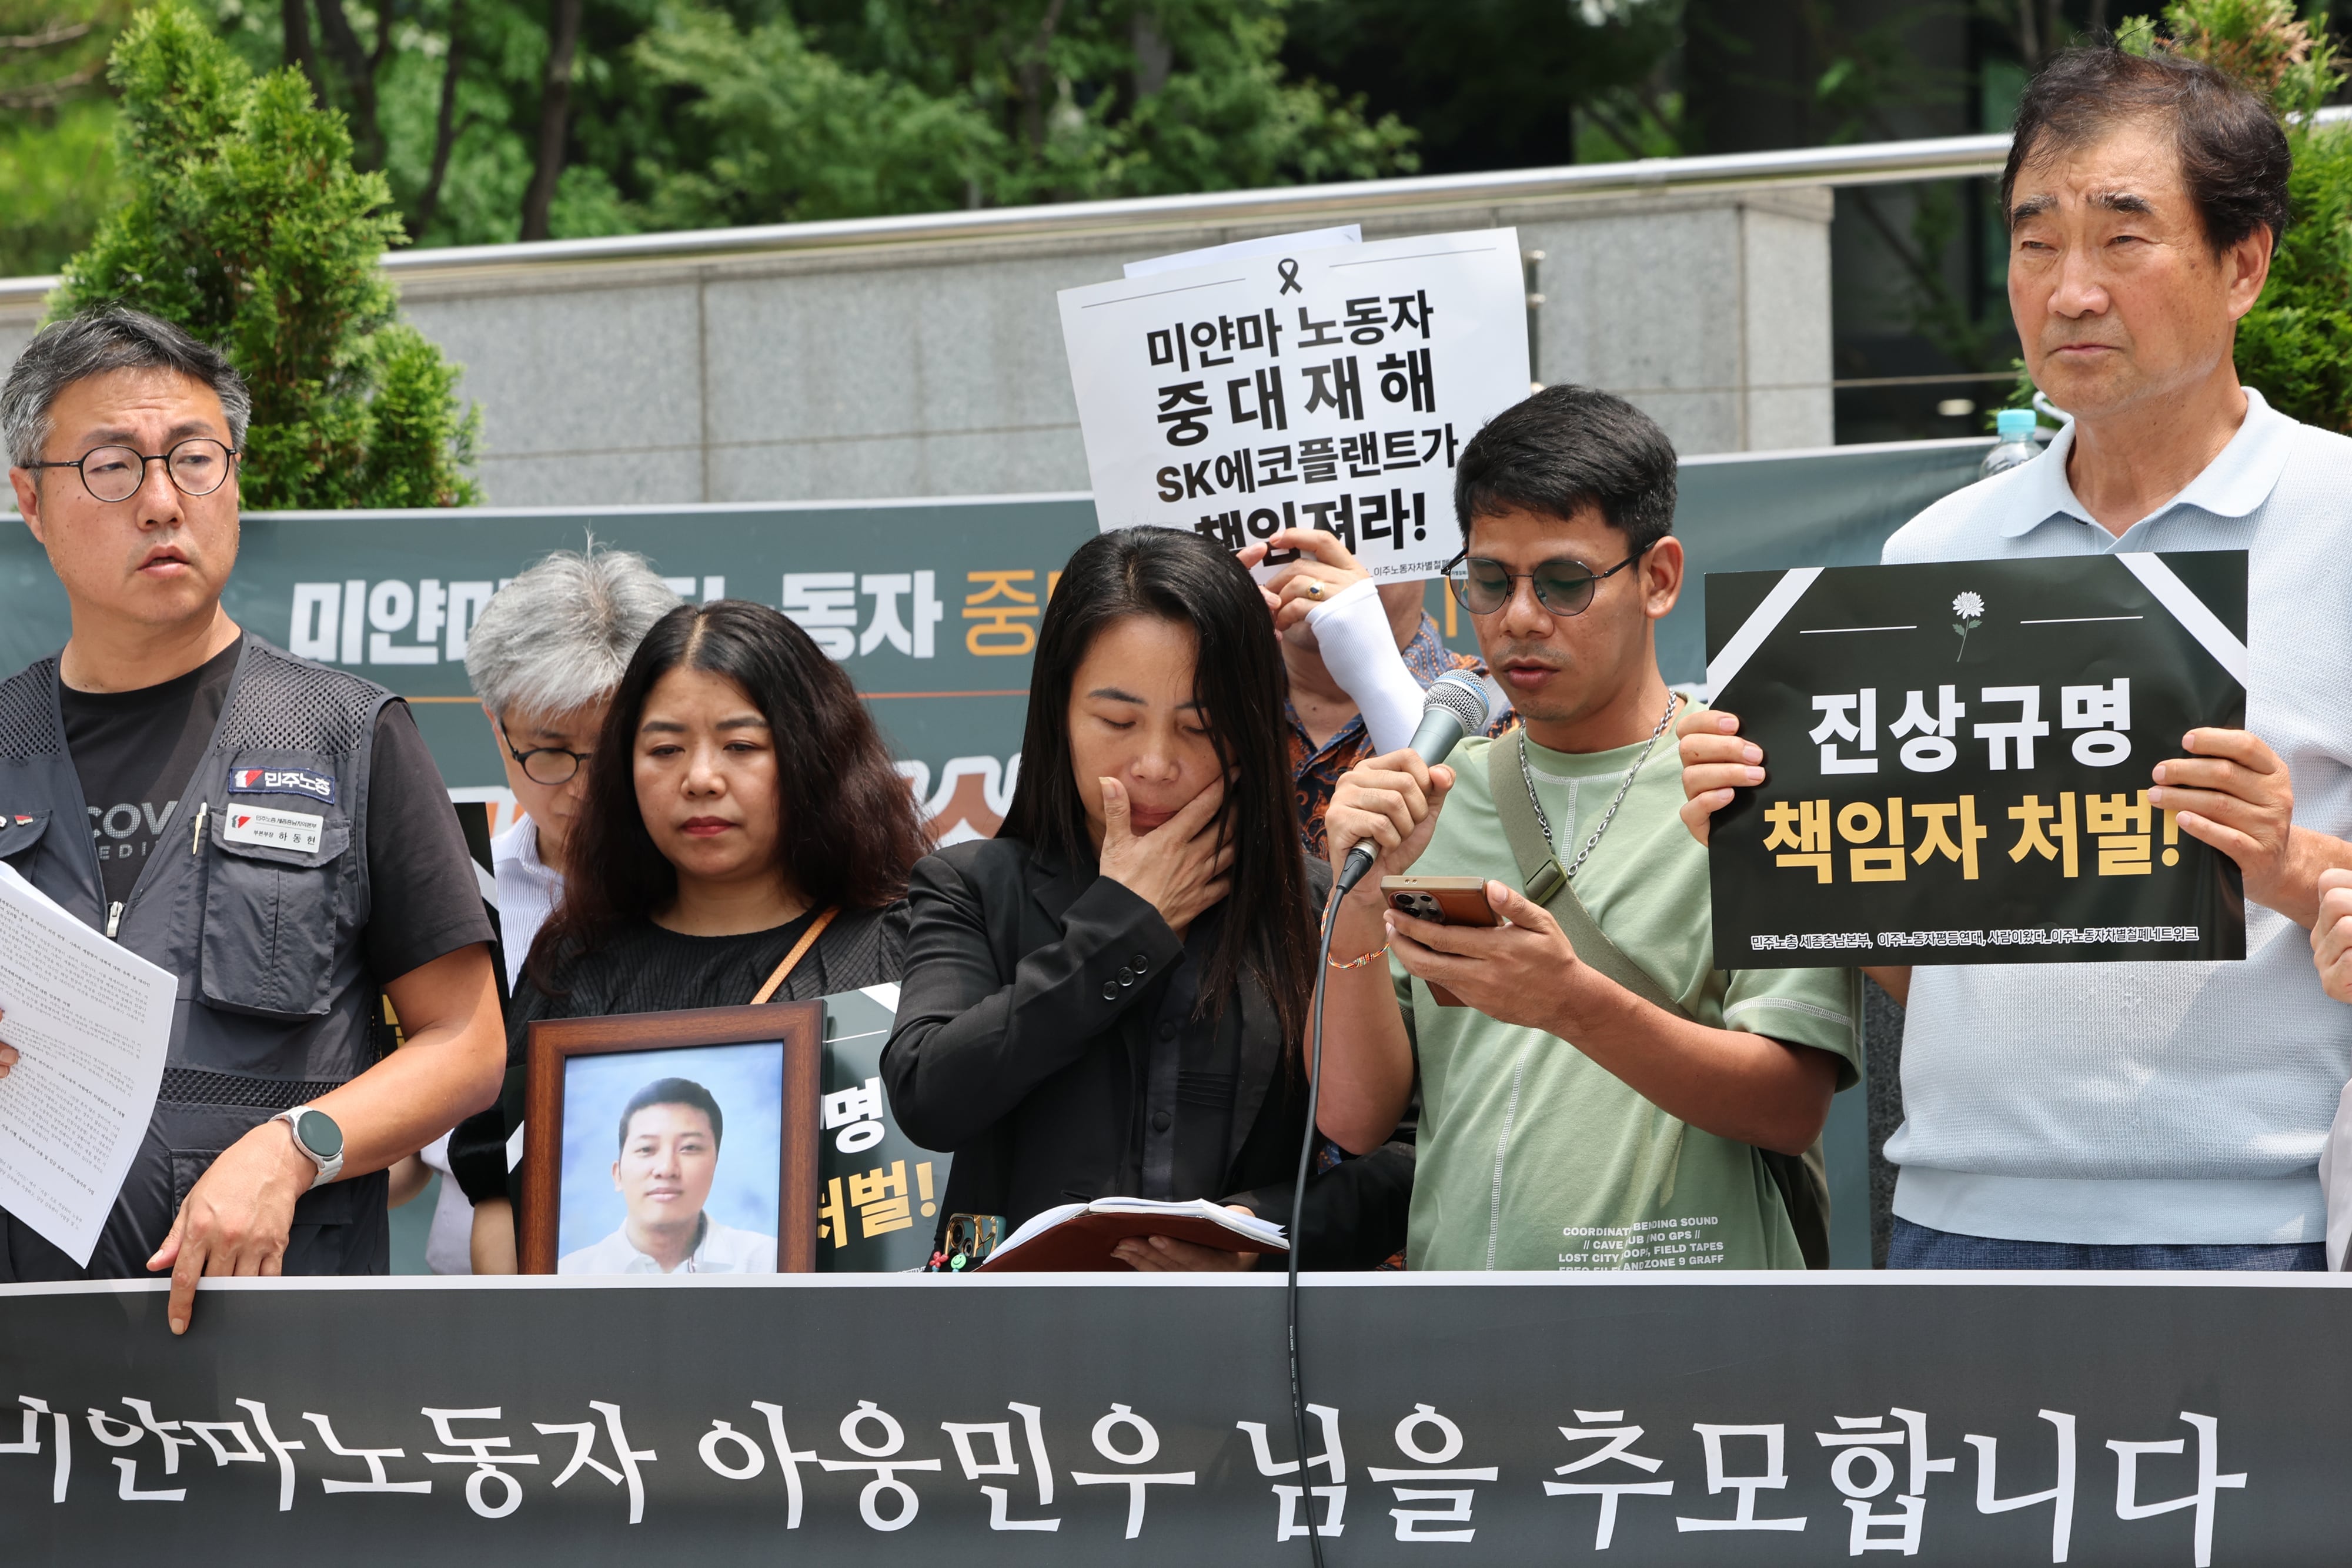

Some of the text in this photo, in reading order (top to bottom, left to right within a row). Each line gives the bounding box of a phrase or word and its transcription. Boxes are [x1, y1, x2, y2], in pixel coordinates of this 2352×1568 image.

[1146, 289, 1434, 372] 미얀마 노동자
[1156, 423, 1458, 503] SK에코플랜트가
[1809, 678, 2132, 775] 진상규명
[265, 772, 330, 795] 민주노총
[1763, 789, 2181, 884] 책임자 처벌!
[1750, 934, 1798, 950] 민주노총
[1799, 932, 1873, 950] 세종충남본부,
[1877, 930, 1986, 948] 이주노동자평등연대,
[1681, 1216, 1718, 1226] SOUND
[1593, 1241, 1623, 1249] CAVE
[1625, 1235, 1644, 1247] UB
[1651, 1233, 1666, 1242] NO
[1669, 1231, 1692, 1240] GPS
[1558, 1253, 1589, 1262] LOST
[1592, 1253, 1619, 1263] CITY
[1654, 1244, 1686, 1255] FIELD
[1690, 1242, 1723, 1252] TAPES
[1645, 1258, 1676, 1268] ZONE
[1679, 1257, 1686, 1266] 9
[1689, 1255, 1724, 1265] GRAFF
[699, 1399, 1197, 1540] 아웅민우
[1236, 1402, 1499, 1543] 님을
[1542, 1406, 2249, 1568] 추모합니다
